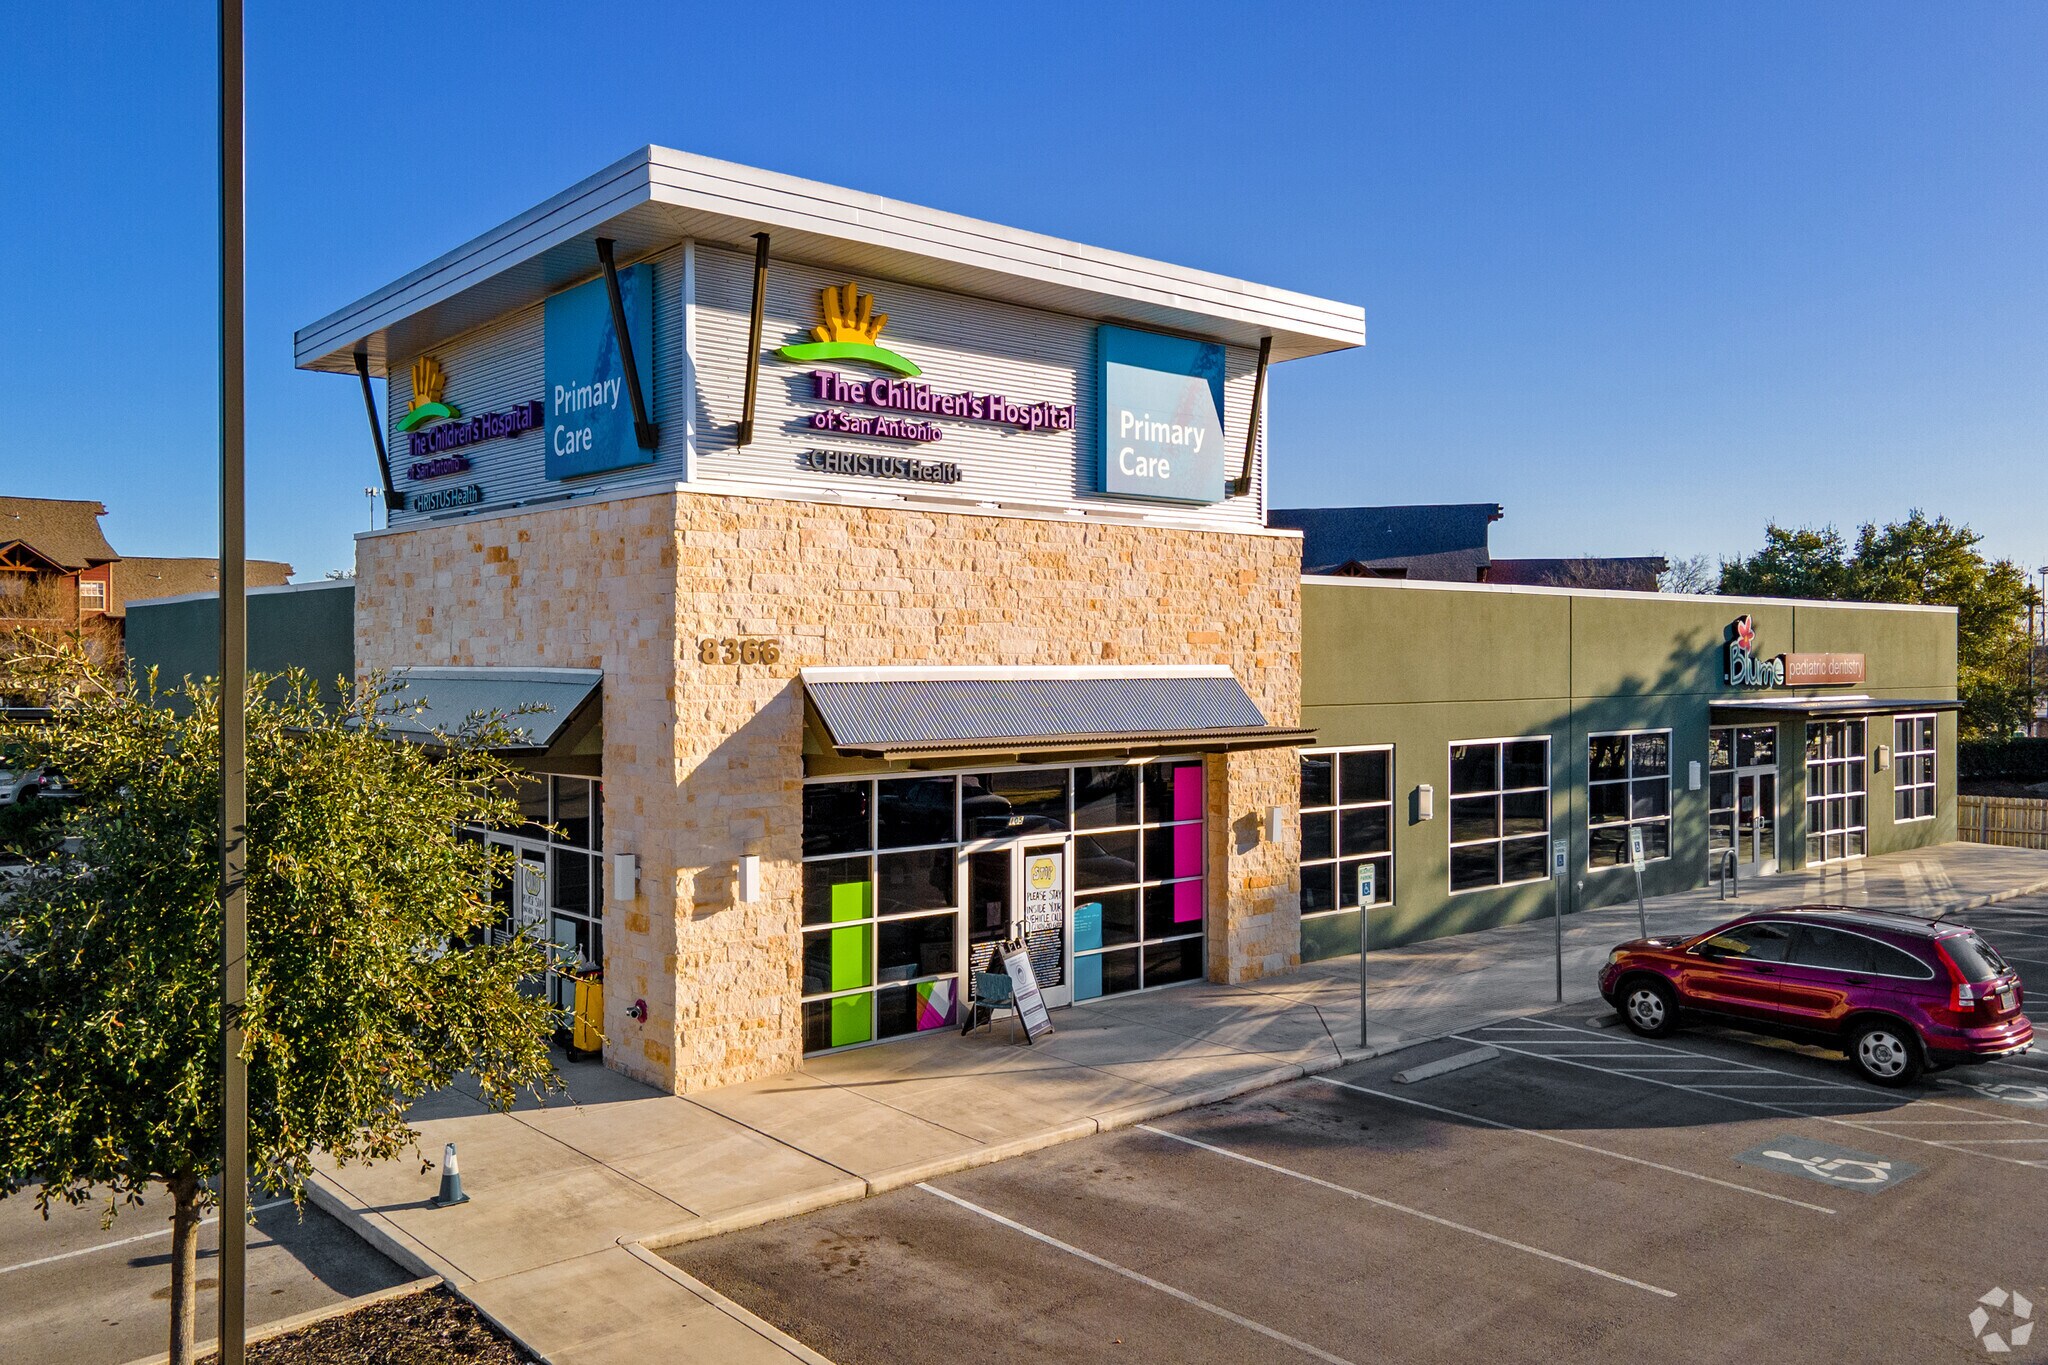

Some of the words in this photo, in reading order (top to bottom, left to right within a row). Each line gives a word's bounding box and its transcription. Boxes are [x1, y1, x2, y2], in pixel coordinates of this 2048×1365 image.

[555, 377, 621, 416] Primary
[815, 370, 864, 403] The
[871, 378, 983, 418] Children's
[989, 394, 1076, 431] Hospital
[408, 433, 427, 456] The
[428, 418, 479, 452] Children's
[482, 400, 533, 438] Hospital
[554, 425, 592, 457] Care
[815, 409, 834, 429] of
[839, 411, 871, 434] San
[875, 415, 943, 441] Antonio
[1120, 410, 1205, 453] Primary
[406, 464, 416, 480] of
[416, 463, 430, 479] San
[430, 457, 460, 477] Antonio
[811, 449, 905, 477] CHRISTUS
[909, 460, 963, 483] Health
[1119, 447, 1170, 479] Care
[413, 489, 450, 512] CHRISTUS
[451, 485, 478, 506] Health
[702, 638, 780, 665] 8366
[1730, 640, 1784, 688] Blume
[1789, 660, 1827, 679] pediatric
[1828, 658, 1863, 678] dentistry
[1027, 891, 1046, 902] PLEASE
[1049, 889, 1062, 900] STAY
[1027, 903, 1046, 914] INSIDE
[1049, 902, 1062, 912] YOUR
